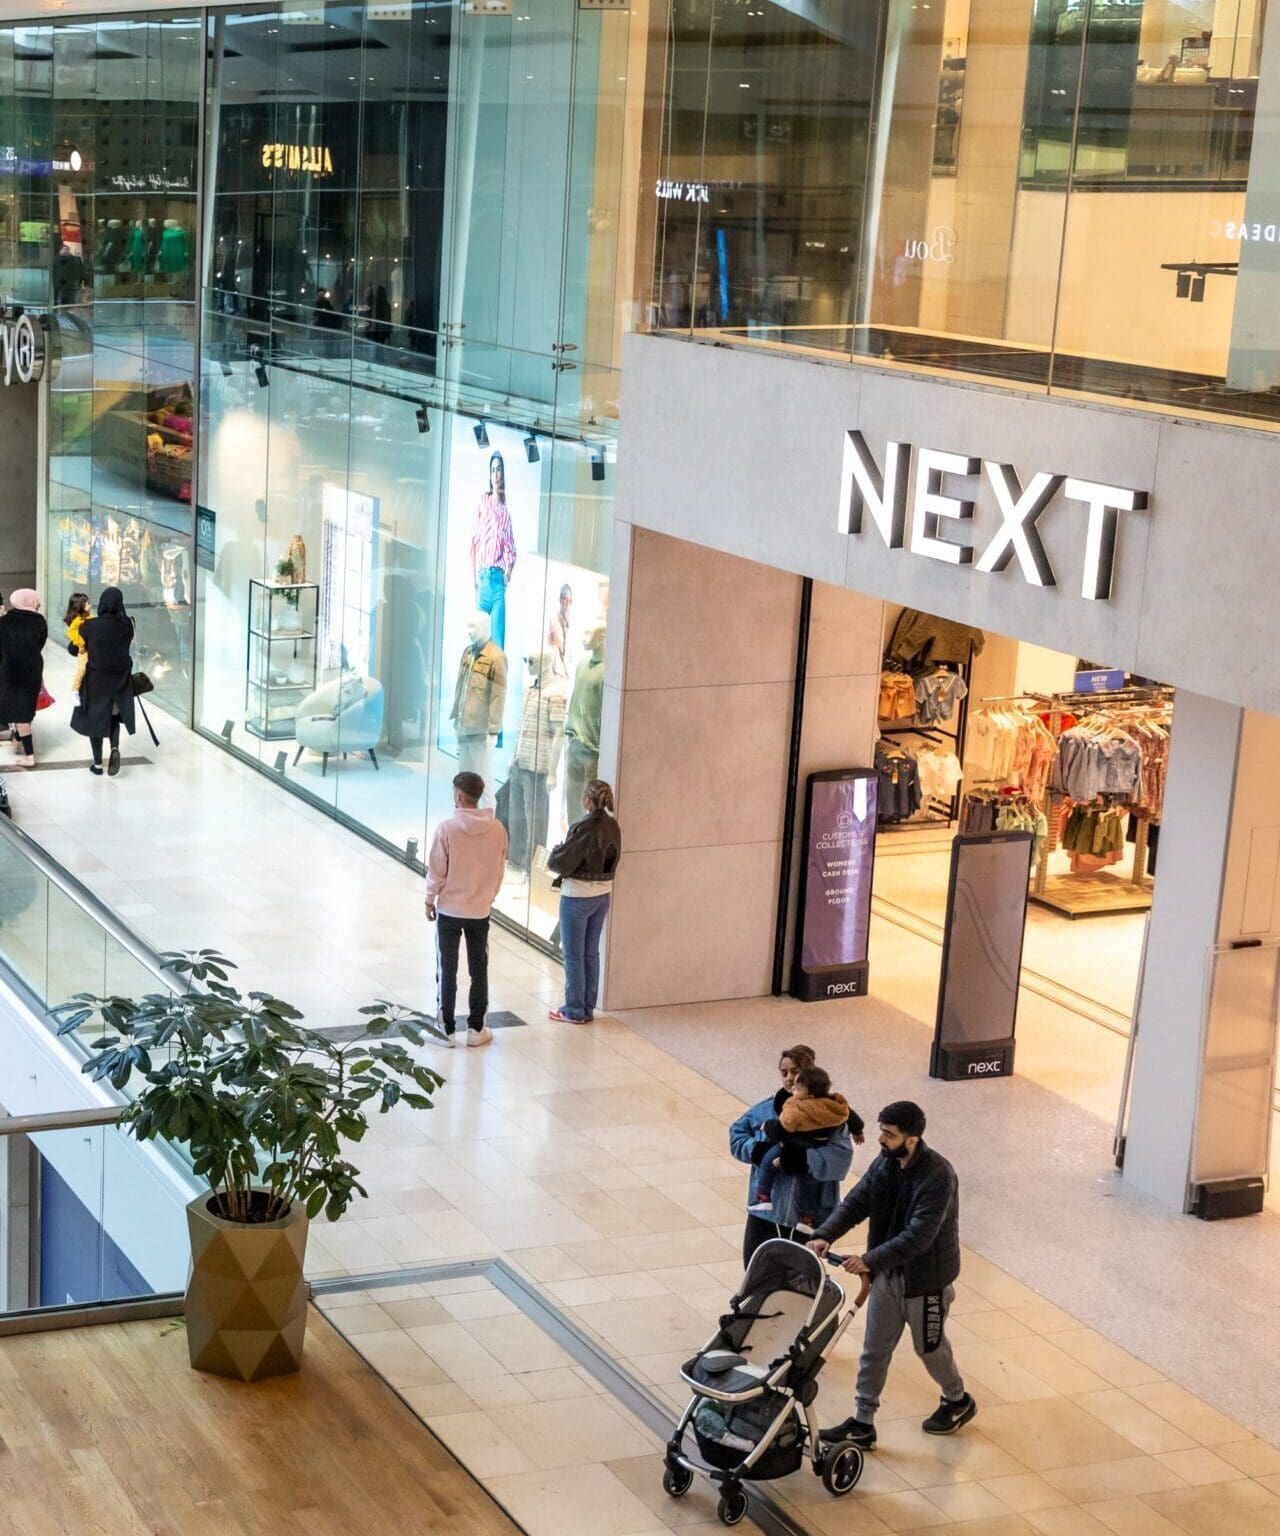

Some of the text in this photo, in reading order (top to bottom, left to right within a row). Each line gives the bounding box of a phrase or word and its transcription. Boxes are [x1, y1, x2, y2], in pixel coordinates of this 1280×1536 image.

[837, 429, 1149, 601] NEXT
[822, 870, 841, 878] CASH
[827, 981, 856, 995] next
[968, 1060, 1001, 1075] next
